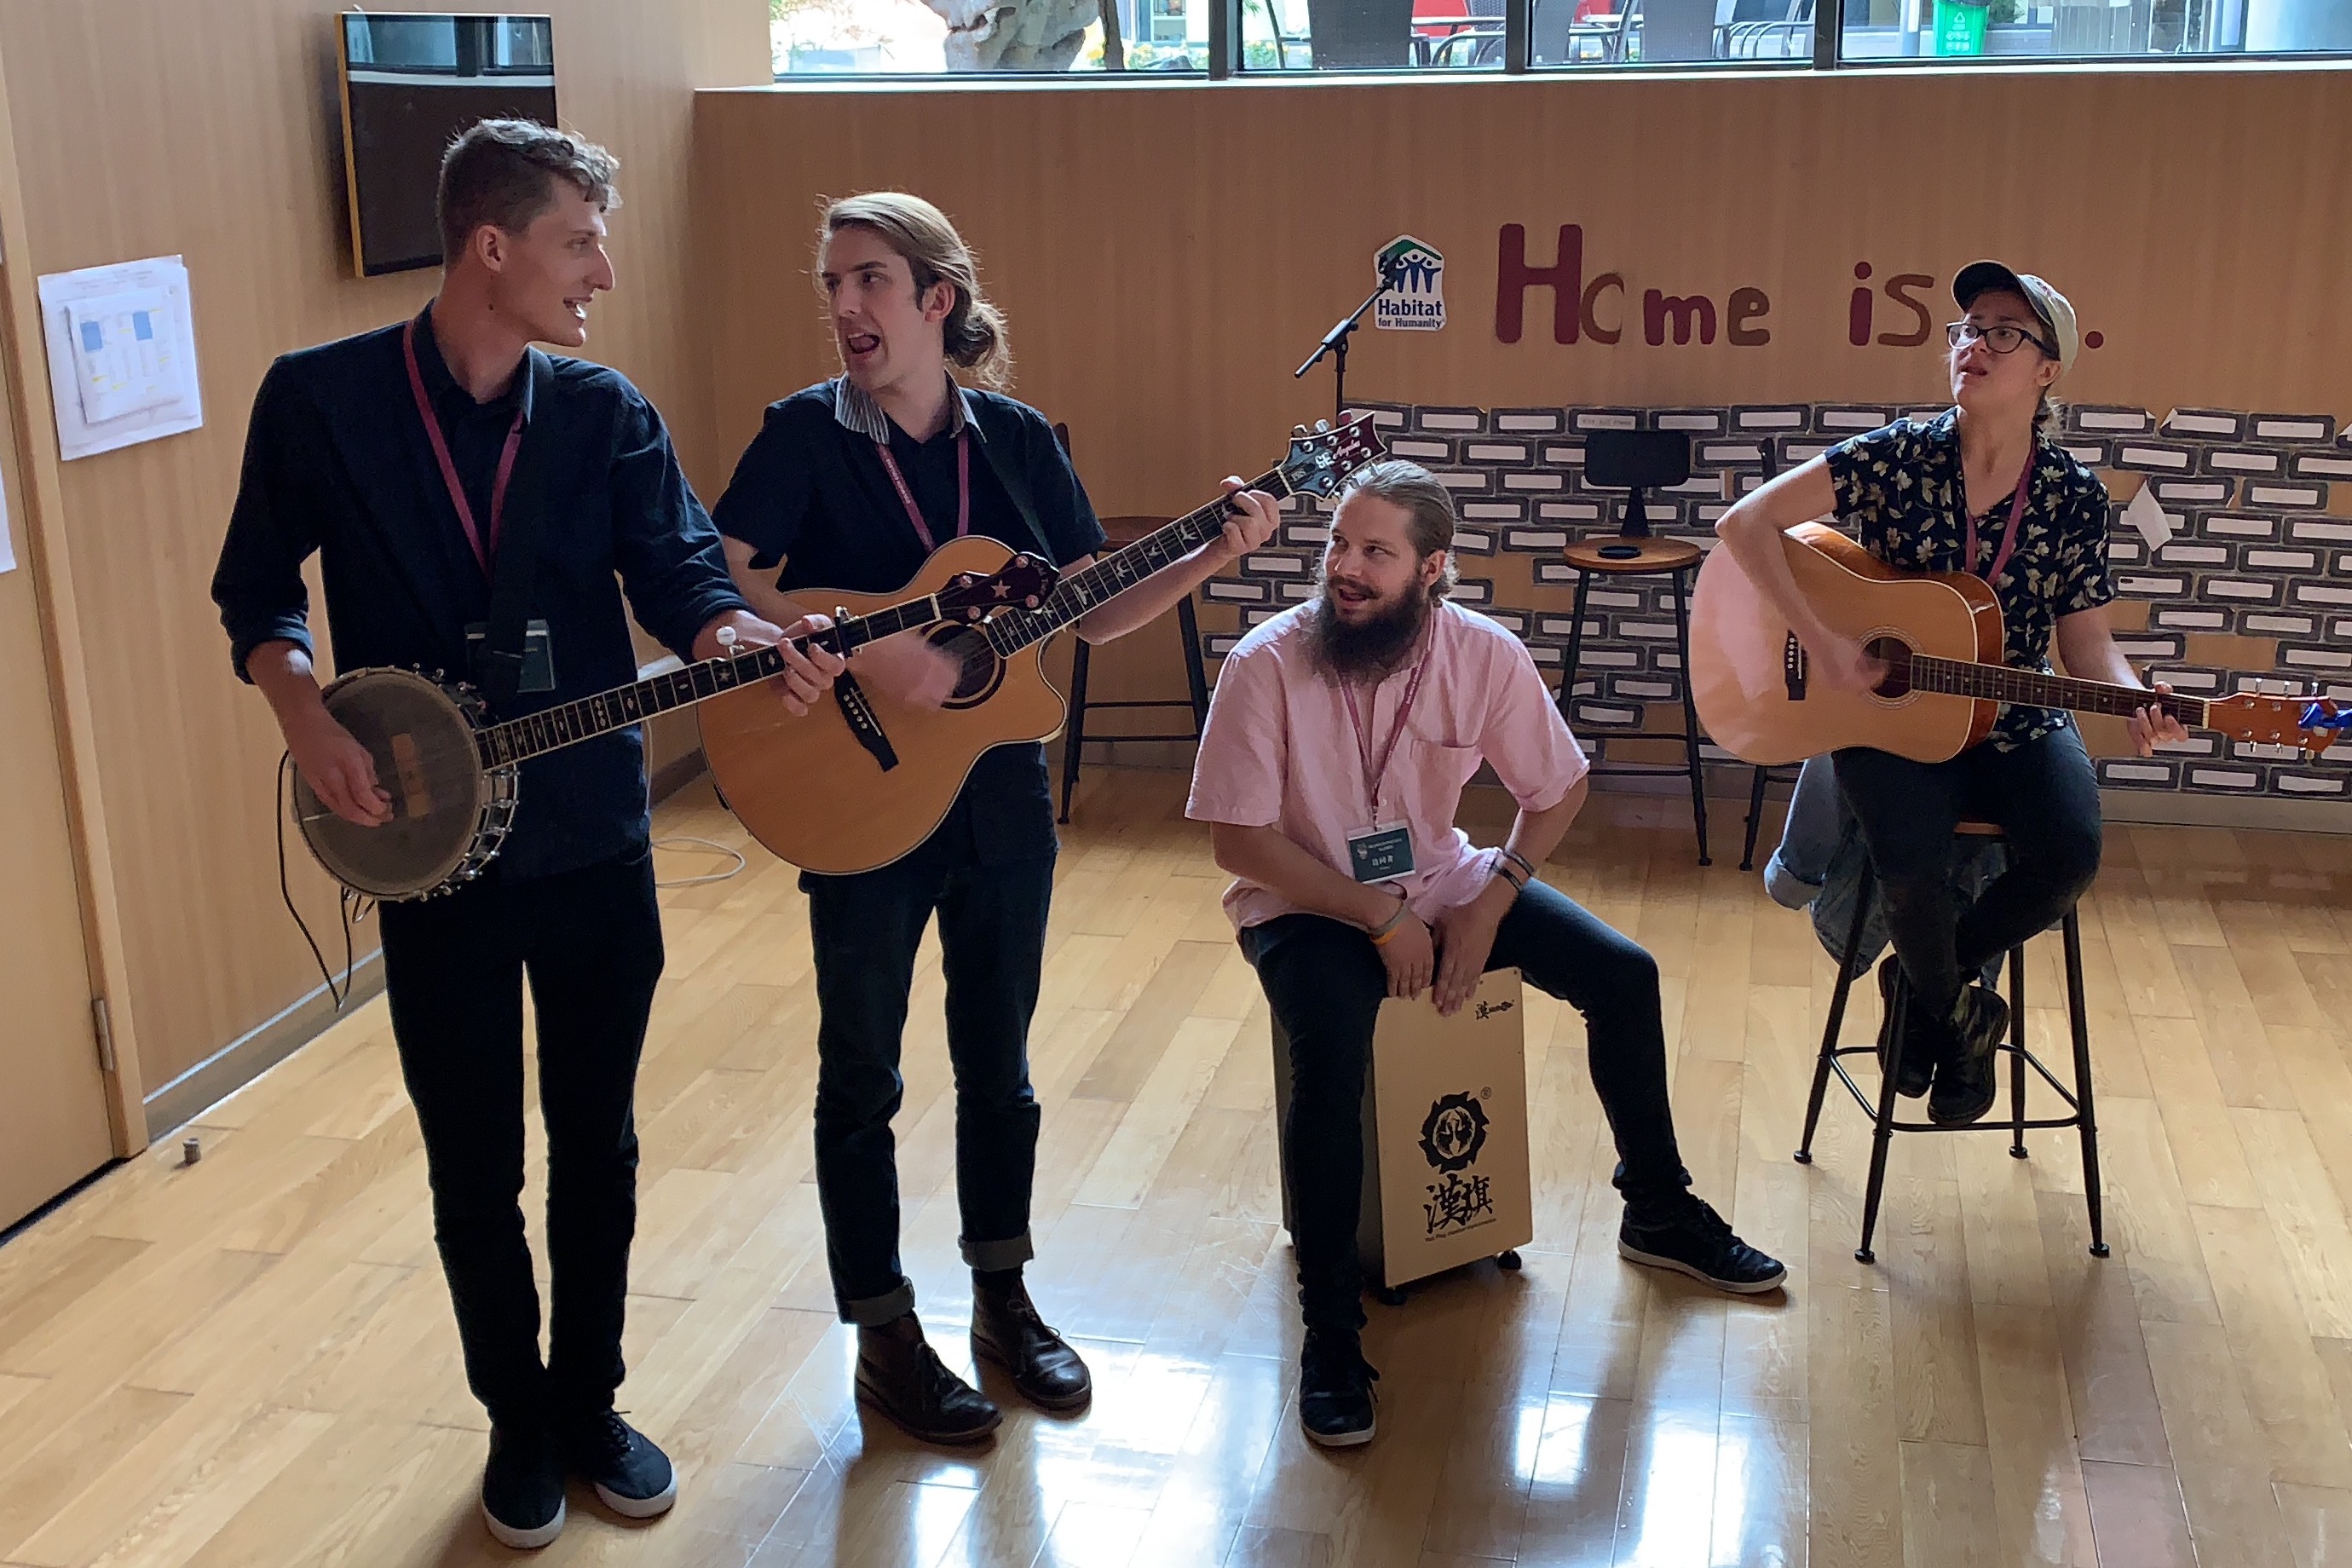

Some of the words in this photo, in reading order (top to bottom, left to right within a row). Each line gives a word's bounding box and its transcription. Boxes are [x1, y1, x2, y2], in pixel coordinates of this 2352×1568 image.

[1378, 298, 1442, 316] Habitat
[1849, 261, 1934, 347] is
[1378, 317, 1392, 327] for
[1395, 317, 1442, 330] Humanity
